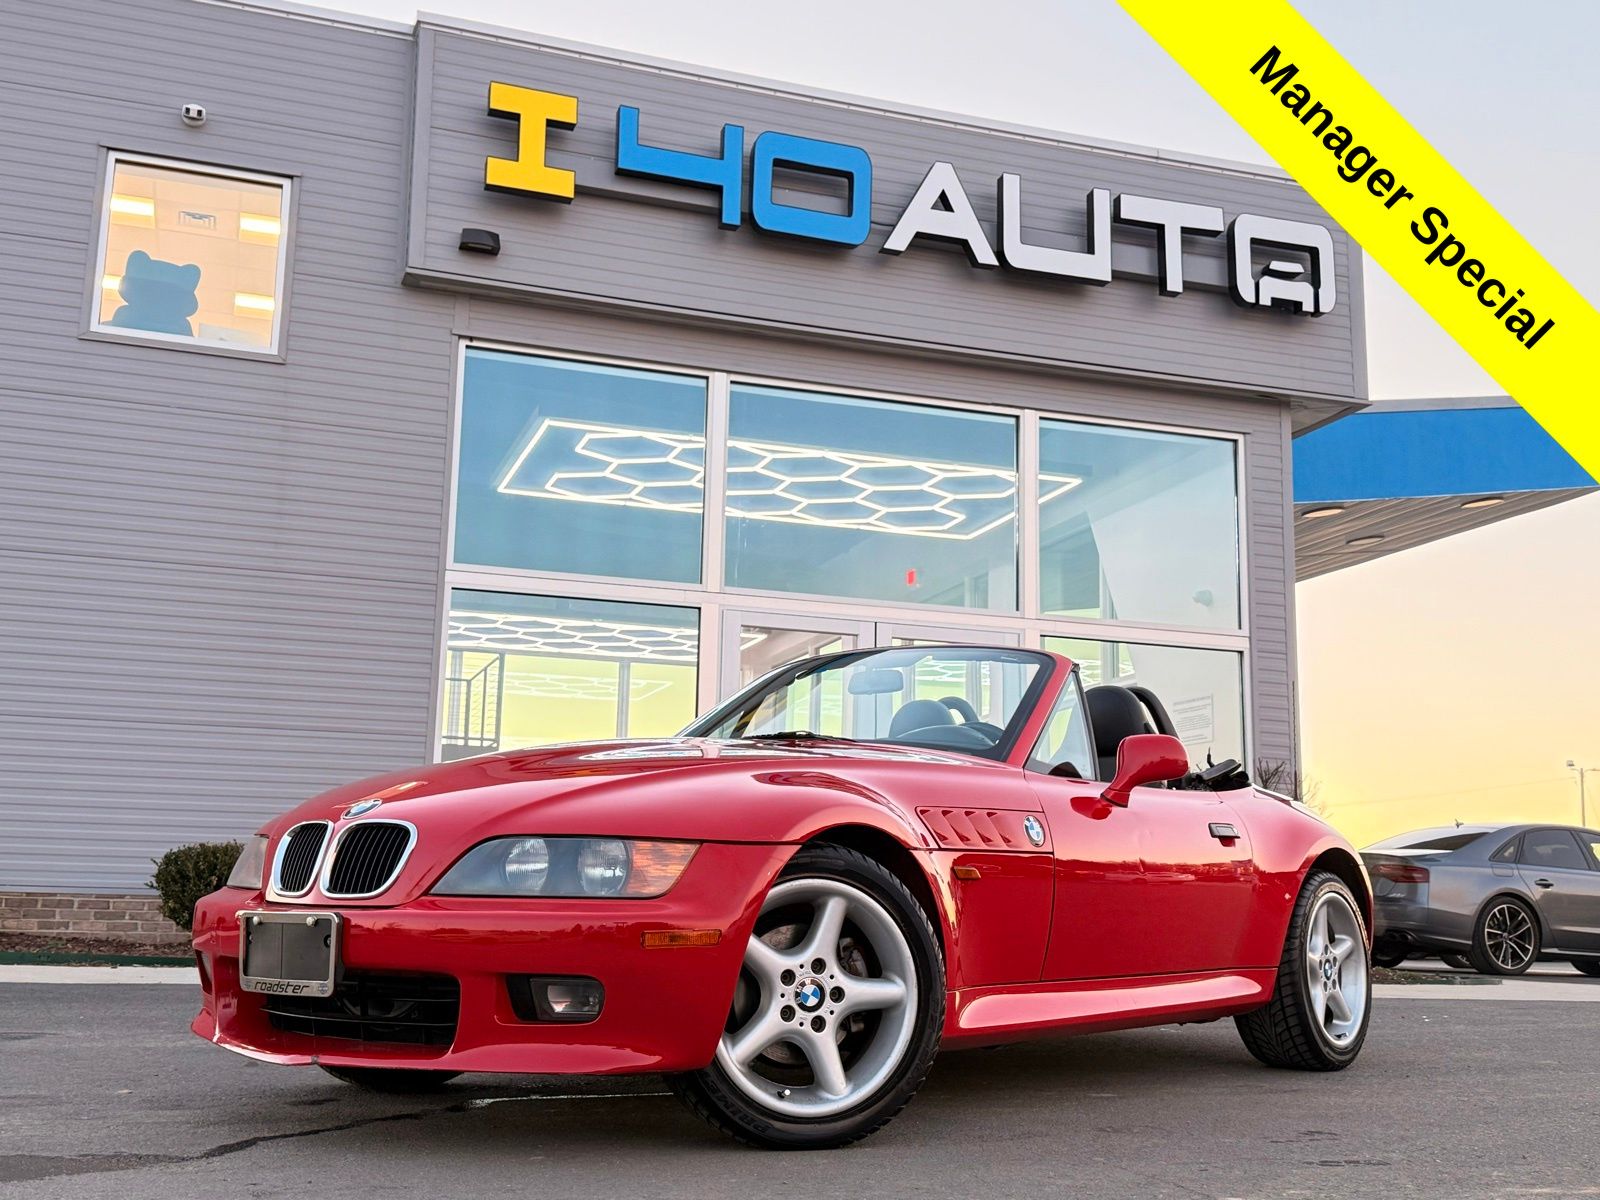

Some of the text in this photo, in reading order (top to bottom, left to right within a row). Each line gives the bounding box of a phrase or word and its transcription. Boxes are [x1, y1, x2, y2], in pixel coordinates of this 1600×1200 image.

[486, 81, 1336, 316] I 40 AUTO
[254, 980, 310, 994] roadster
